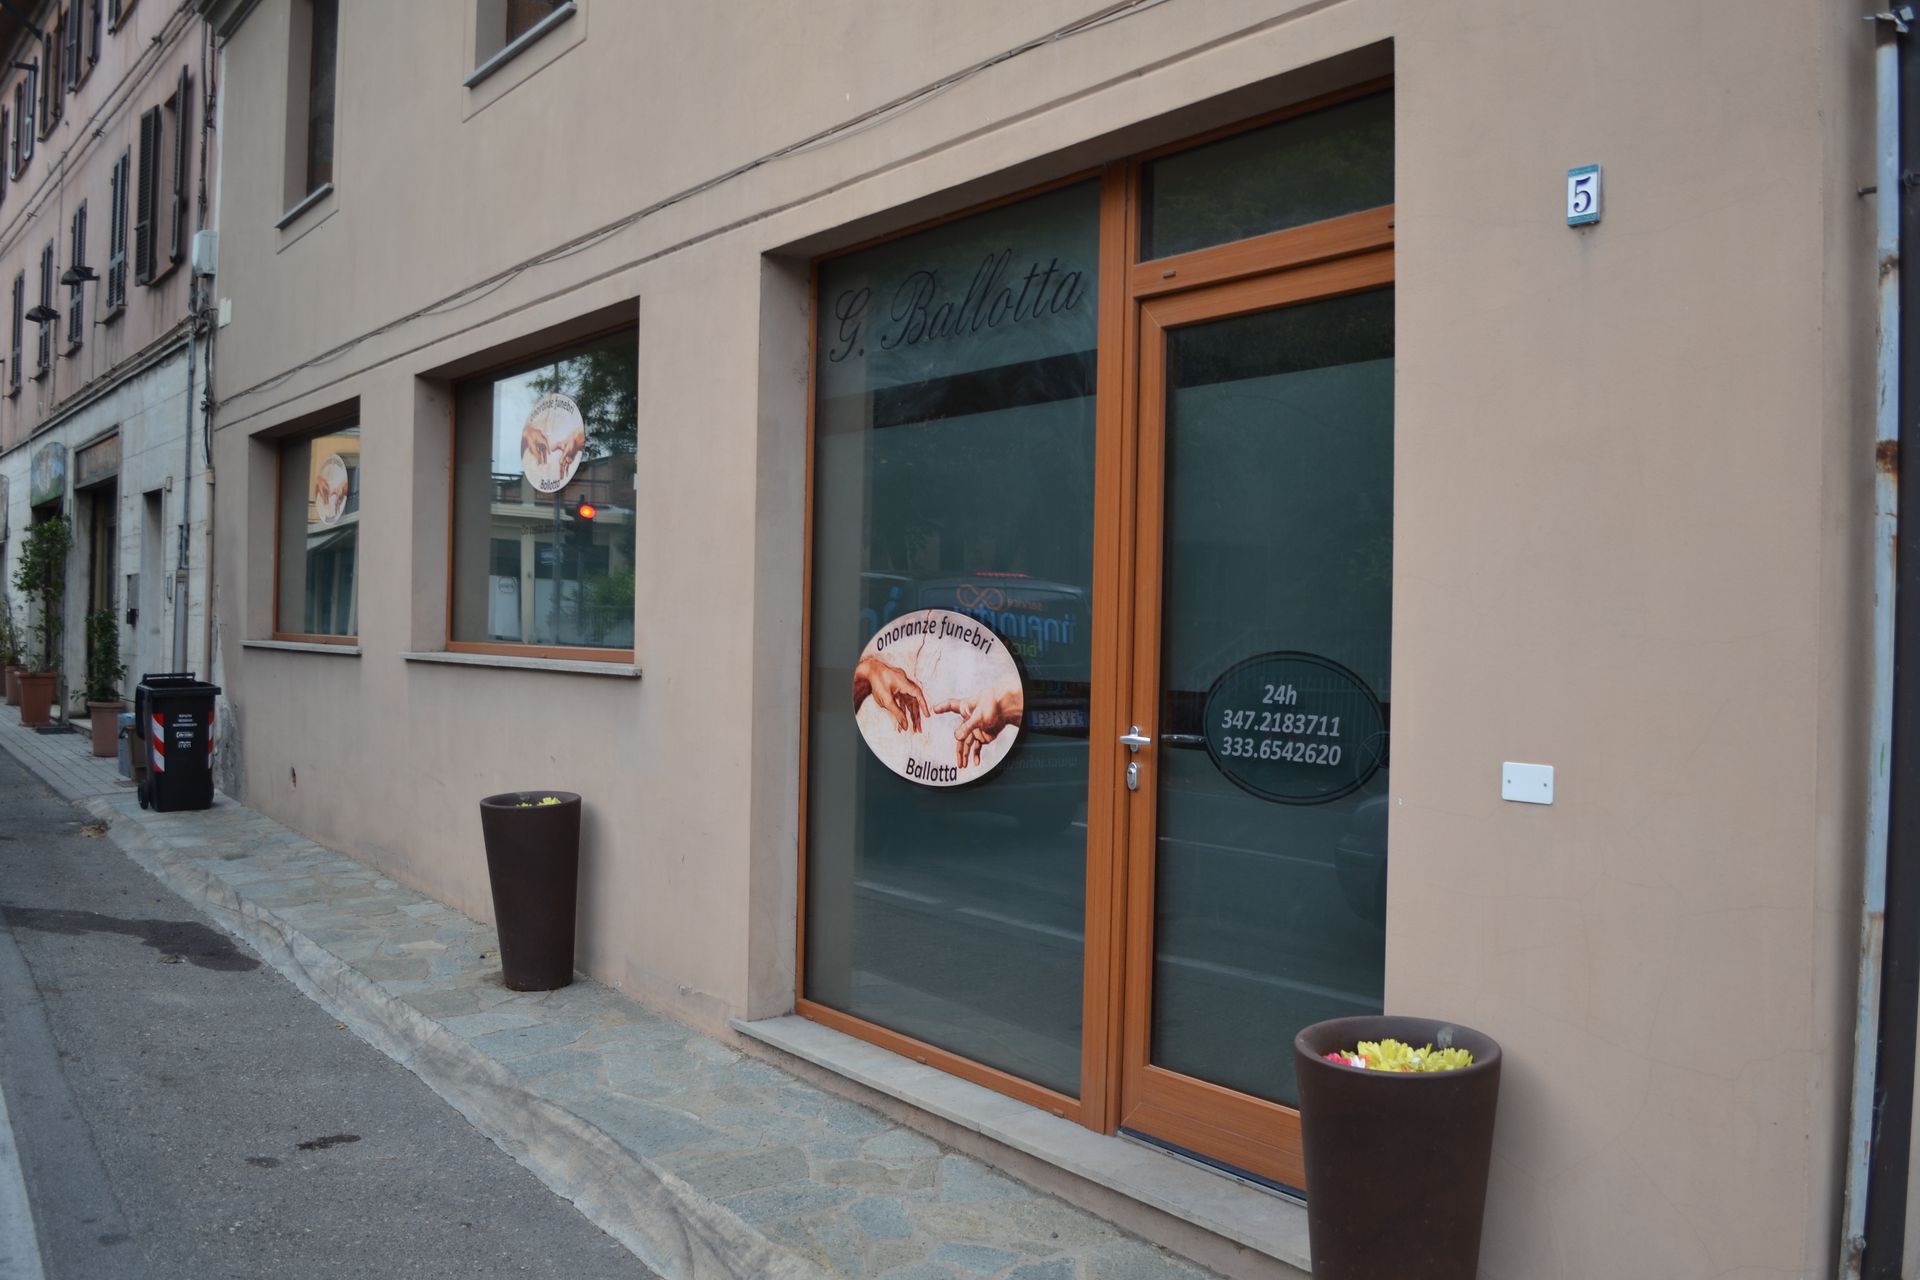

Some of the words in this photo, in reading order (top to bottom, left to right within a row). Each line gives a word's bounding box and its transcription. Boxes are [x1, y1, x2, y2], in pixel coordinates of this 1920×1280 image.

[1573, 175, 1592, 213] 5
[829, 286, 872, 363] G.
[880, 248, 1085, 351] Ballotta
[876, 617, 937, 652] onoranze
[938, 615, 995, 655] funebri
[1261, 683, 1299, 706] 24h
[1221, 708, 1342, 738] 347.2183711
[1220, 736, 1342, 767] 333.6542620
[905, 757, 958, 783] Ballotta
